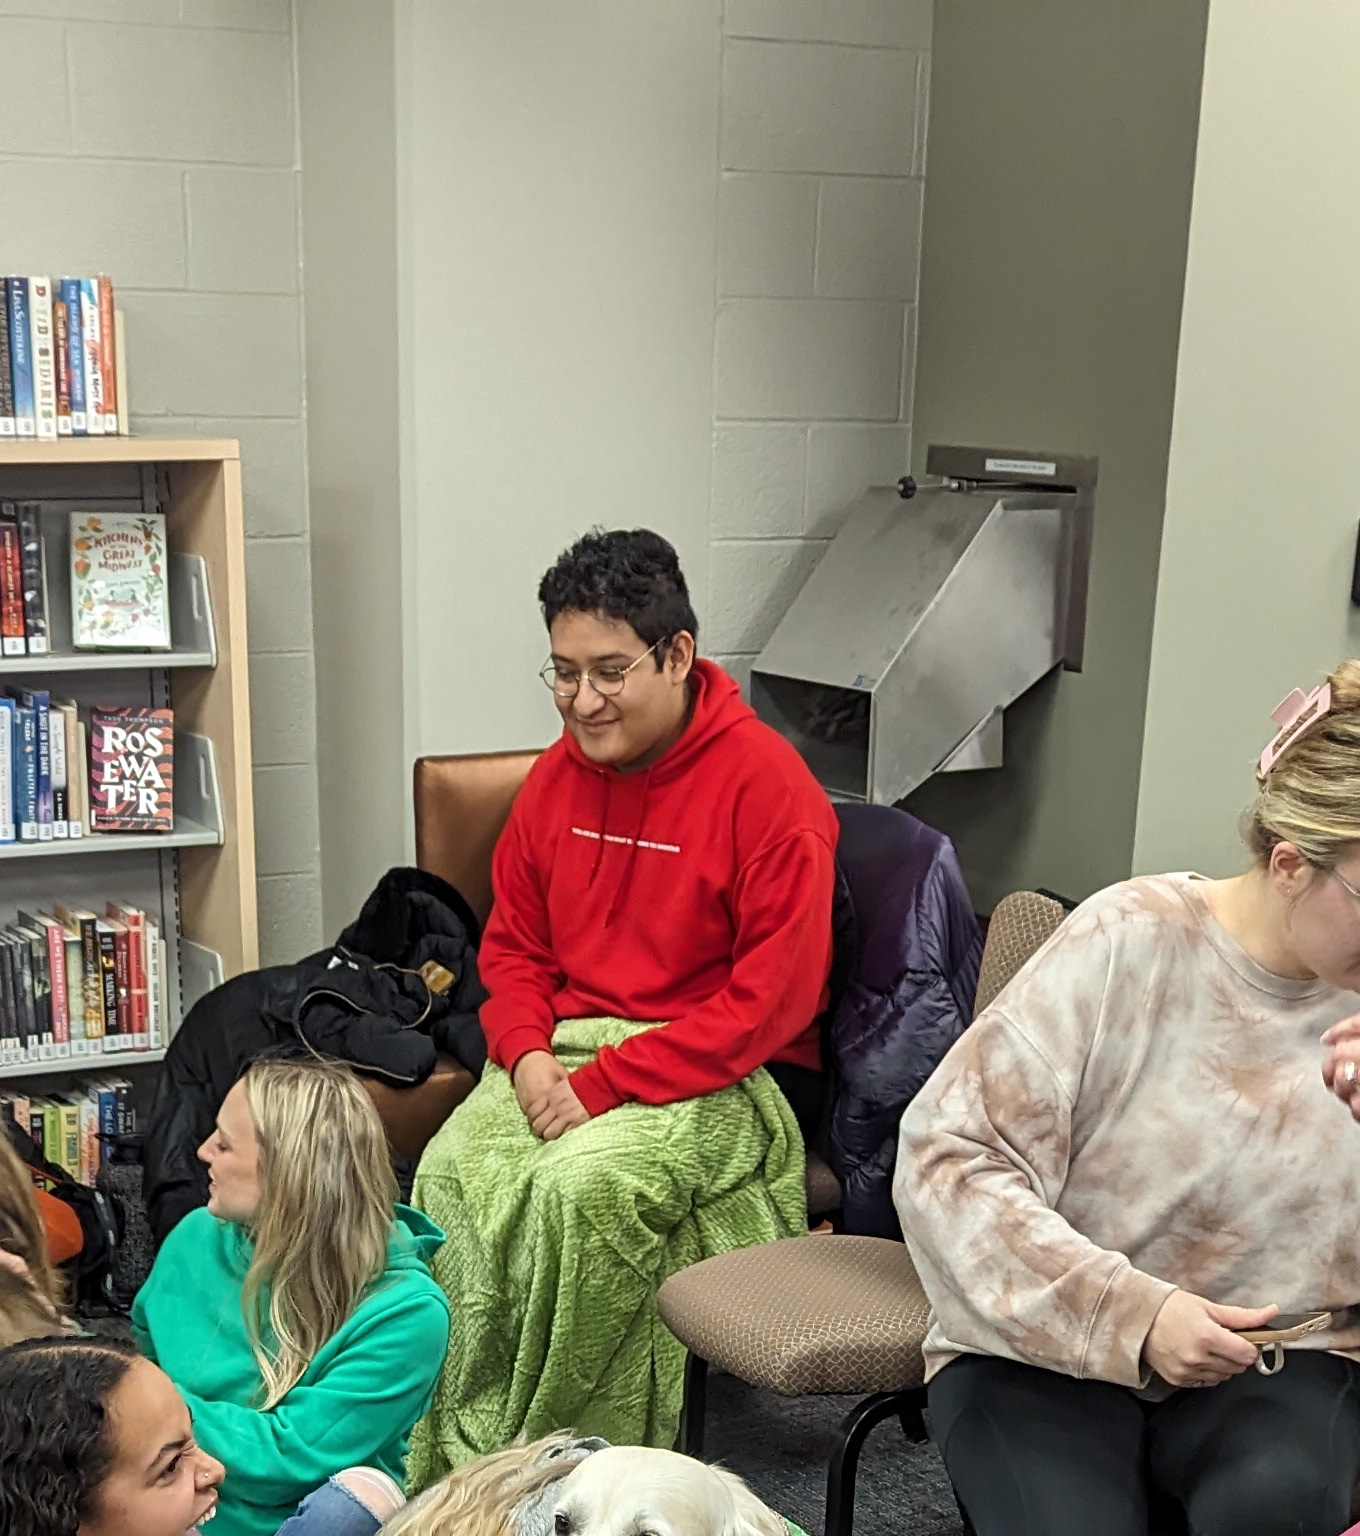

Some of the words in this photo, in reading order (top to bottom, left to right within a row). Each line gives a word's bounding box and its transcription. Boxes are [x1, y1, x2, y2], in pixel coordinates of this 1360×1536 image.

[69, 285, 78, 300] THE
[69, 302, 78, 333] ISLAND
[71, 335, 80, 346] OF
[38, 347, 53, 419] SEDARIS
[73, 368, 82, 401] WOMEN
[94, 532, 143, 548] KITCHENS
[102, 549, 135, 560] GREAT
[98, 559, 143, 572] MIDWEST
[40, 713, 48, 731] SHOT
[124, 716, 164, 724] THOMPSON
[40, 732, 49, 740] IN
[40, 742, 48, 755] THE
[41, 757, 49, 775] DARK
[55, 946, 62, 957] WE
